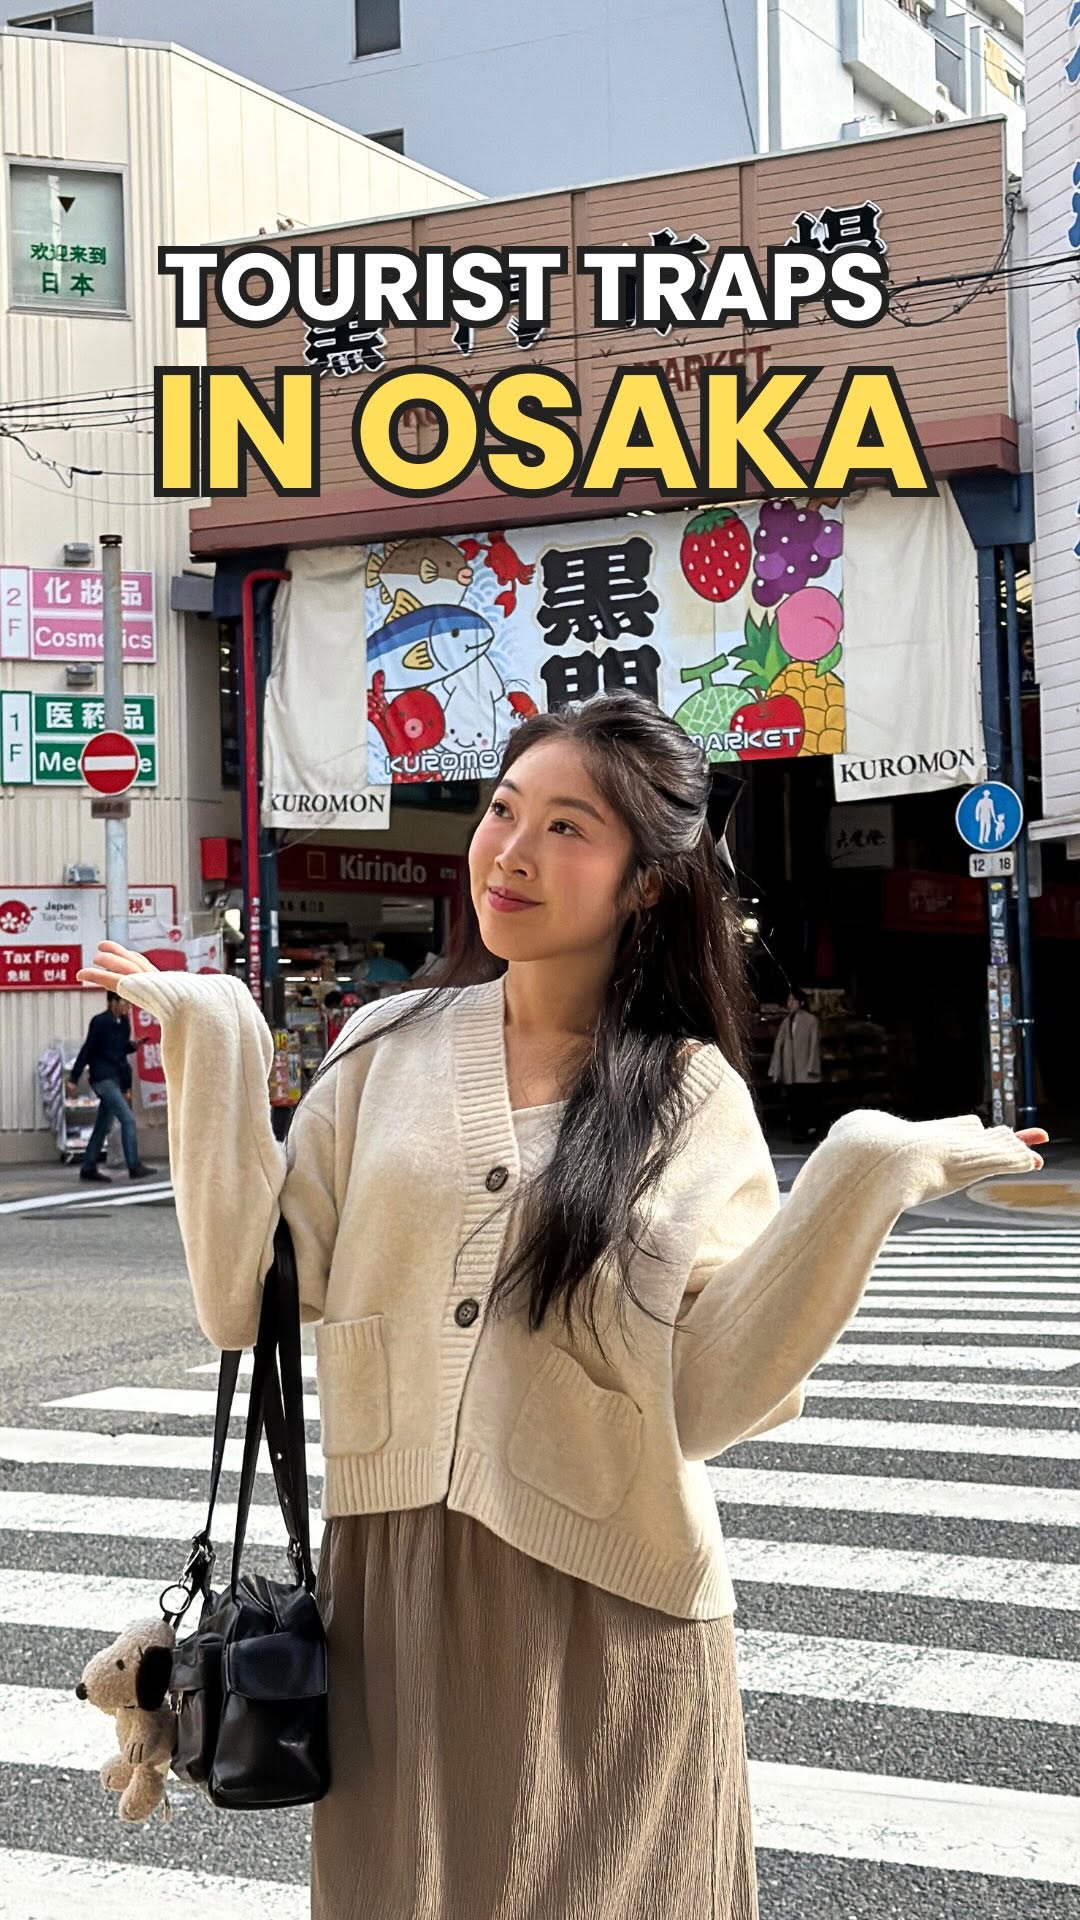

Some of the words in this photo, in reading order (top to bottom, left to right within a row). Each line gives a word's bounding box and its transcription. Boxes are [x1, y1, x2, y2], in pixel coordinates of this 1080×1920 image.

[30, 242, 107, 265] 欢迎来到
[41, 271, 95, 297] 日本
[35, 627, 152, 649] Cosmeics
[385, 750, 501, 775] KUROMO
[840, 749, 976, 784] KUROMON
[339, 854, 428, 883] Kirindo
[973, 858, 985, 872] 12
[1000, 857, 1012, 871] 18
[3, 950, 32, 964] Tax
[35, 950, 70, 964] Free
